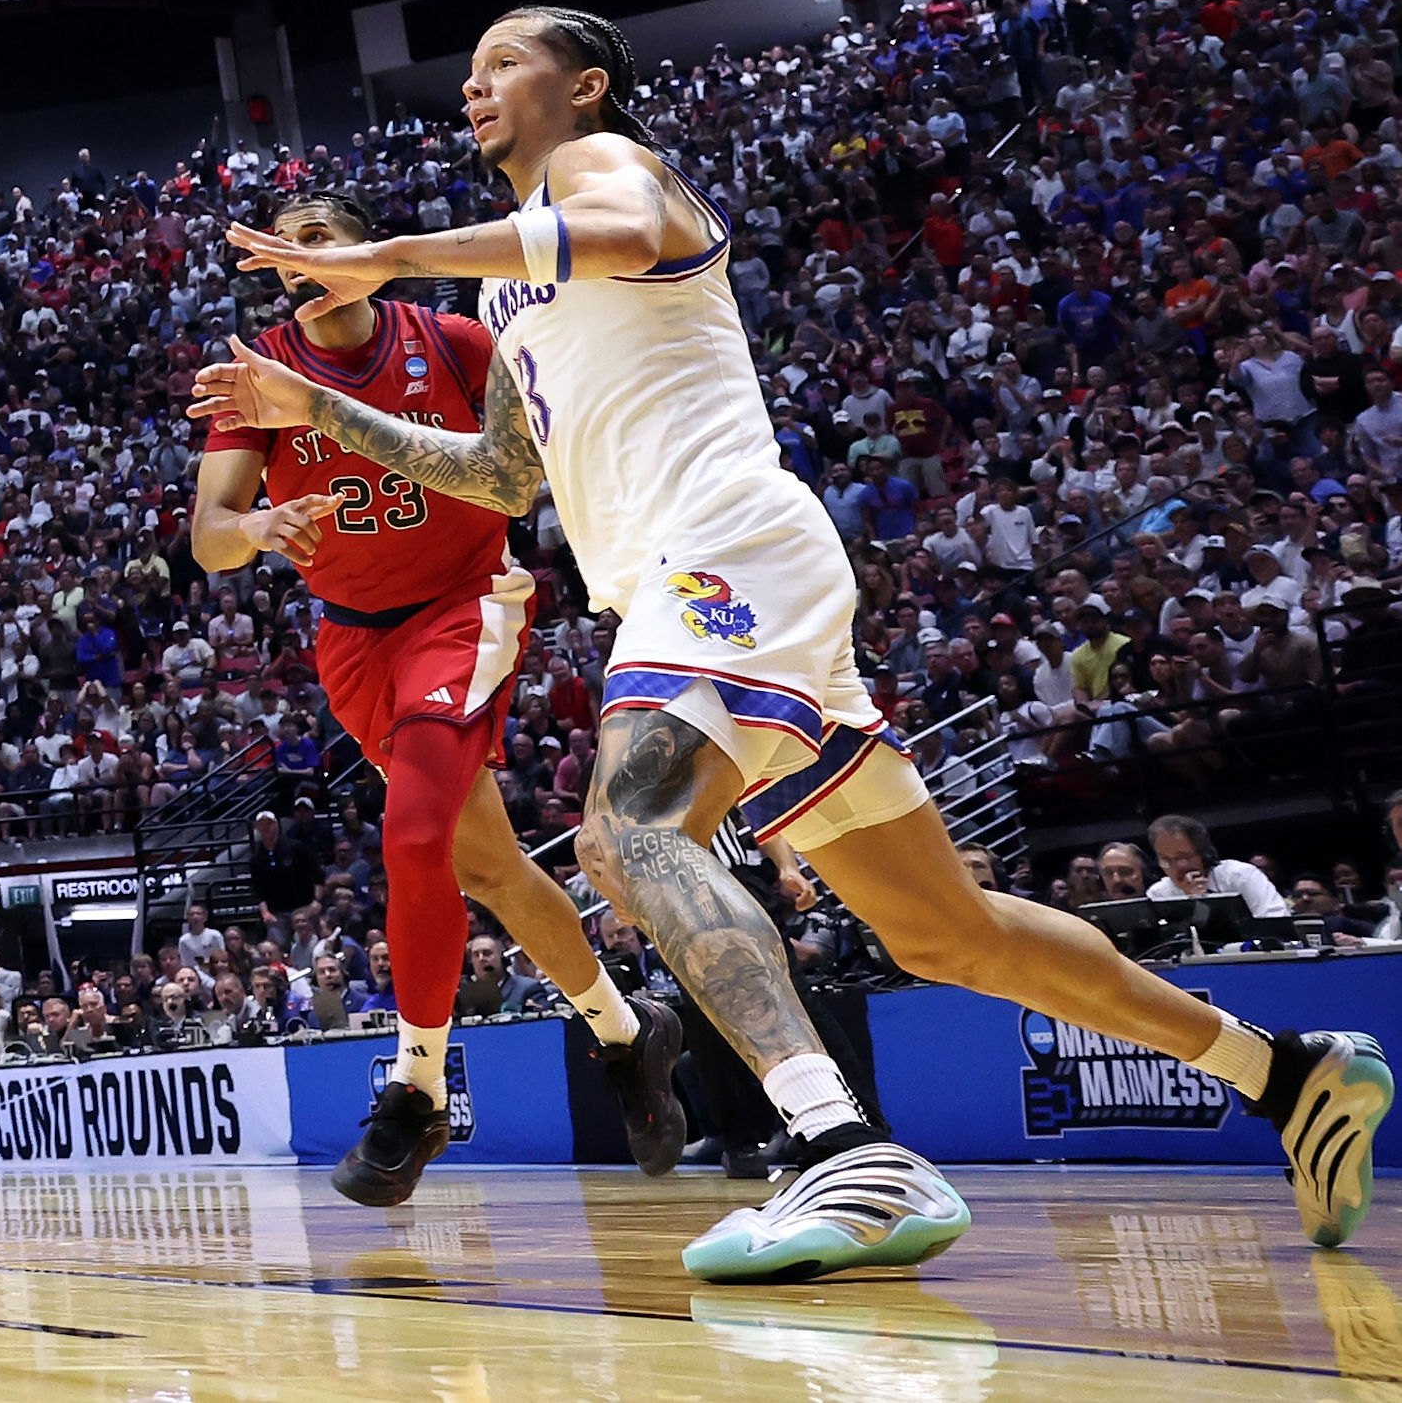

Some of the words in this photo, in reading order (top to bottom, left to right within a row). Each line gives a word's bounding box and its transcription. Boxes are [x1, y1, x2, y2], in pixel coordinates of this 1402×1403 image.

[512, 345, 552, 447] 3
[291, 430, 332, 466] ST.
[328, 470, 429, 535] 23
[709, 607, 735, 626] KU
[76, 1063, 242, 1158] ROUNDS
[1078, 1059, 1226, 1108] MADNESS
